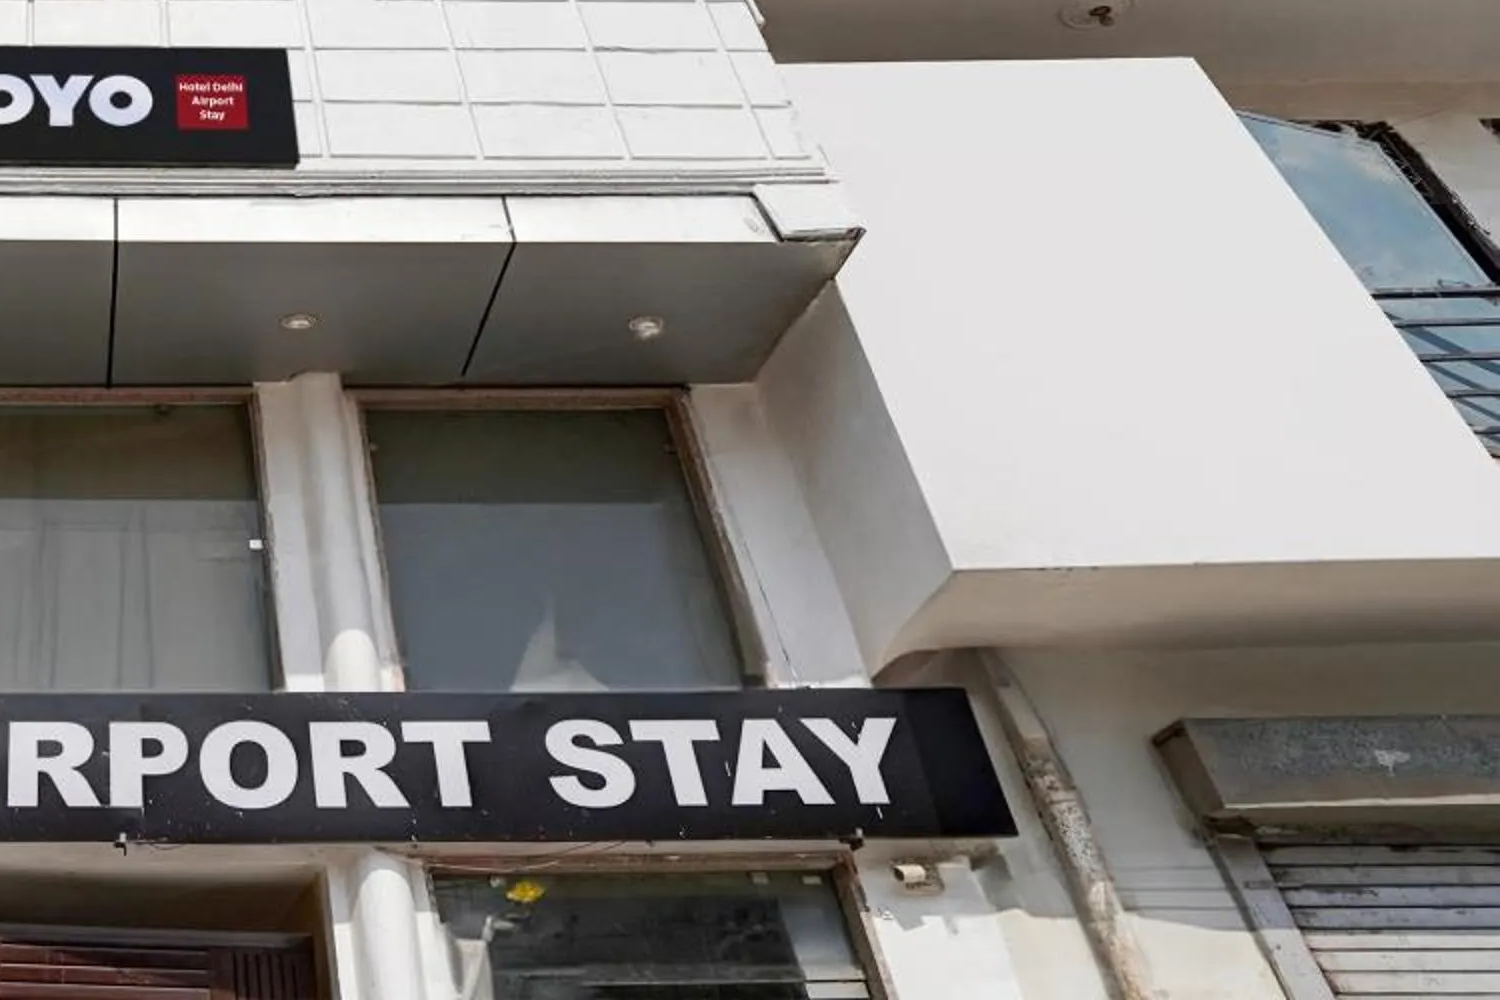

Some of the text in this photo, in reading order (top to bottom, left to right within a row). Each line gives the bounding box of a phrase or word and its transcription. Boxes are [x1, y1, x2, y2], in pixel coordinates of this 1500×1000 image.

[179, 82, 243, 92] Hotel Delhi
[192, 96, 234, 107] Airport
[199, 110, 225, 121] Stay
[545, 717, 897, 808] STAY
